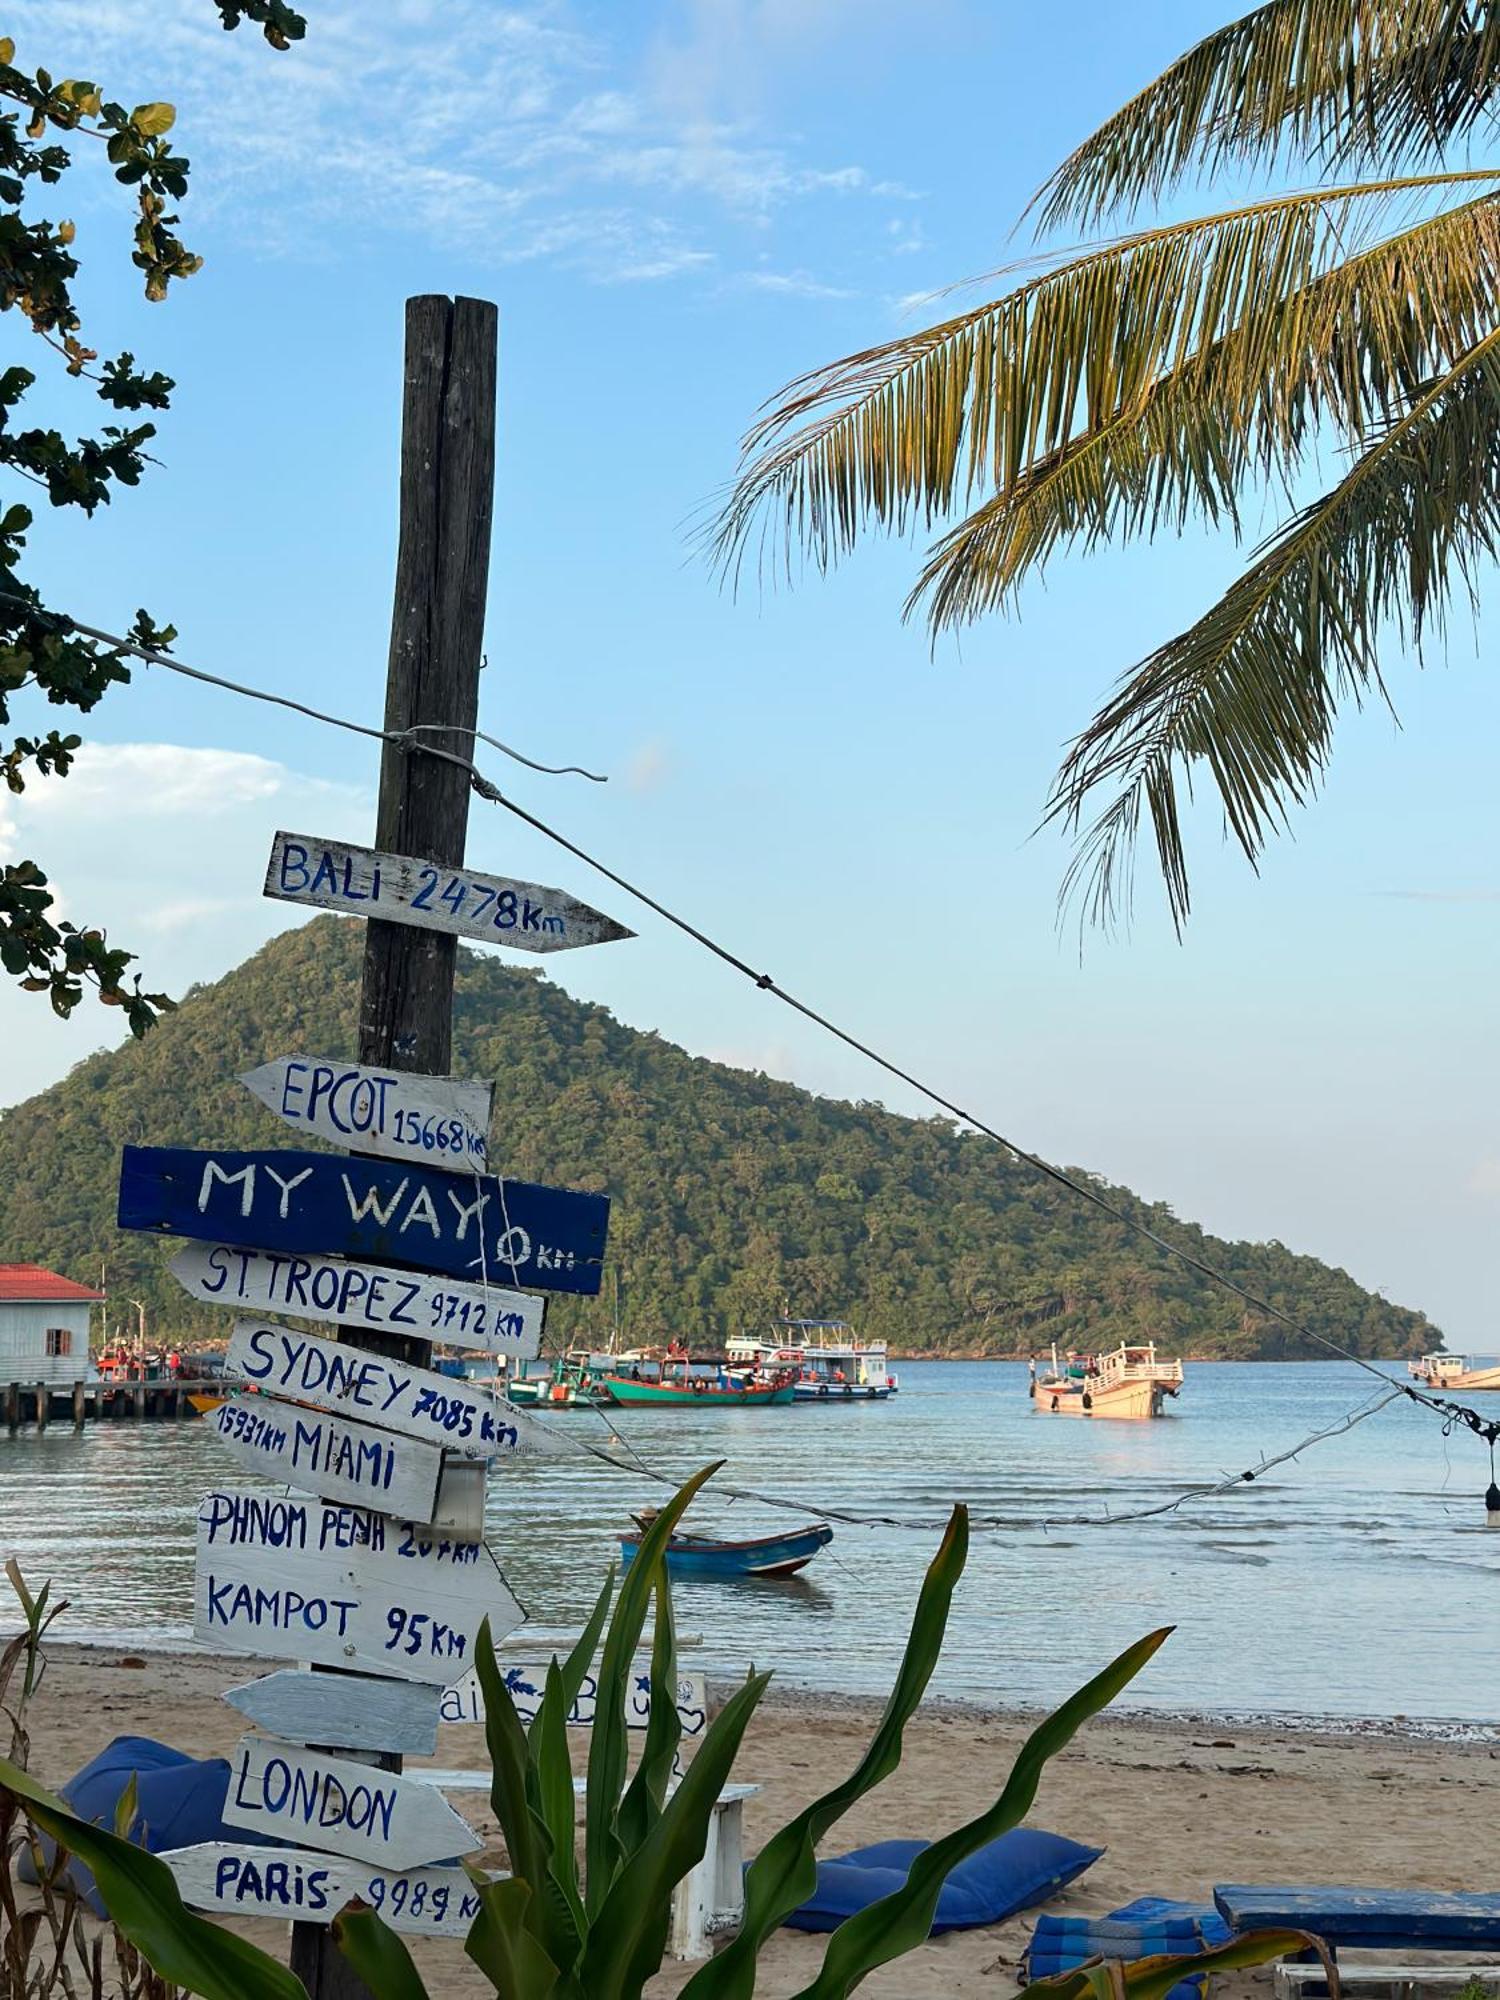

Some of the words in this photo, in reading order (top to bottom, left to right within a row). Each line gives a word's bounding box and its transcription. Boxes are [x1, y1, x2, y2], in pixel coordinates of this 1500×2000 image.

[282, 1063, 398, 1134] EPCOT
[198, 1160, 313, 1218] MY
[341, 1173, 491, 1239] WAY
[266, 1254, 421, 1325] TROPEZ
[242, 1330, 411, 1411] SYDNEY
[199, 1494, 307, 1549] PHNOM
[320, 1508, 385, 1551] PENH
[208, 1576, 359, 1636] KAMPOT
[235, 1750, 397, 1841] LONDON
